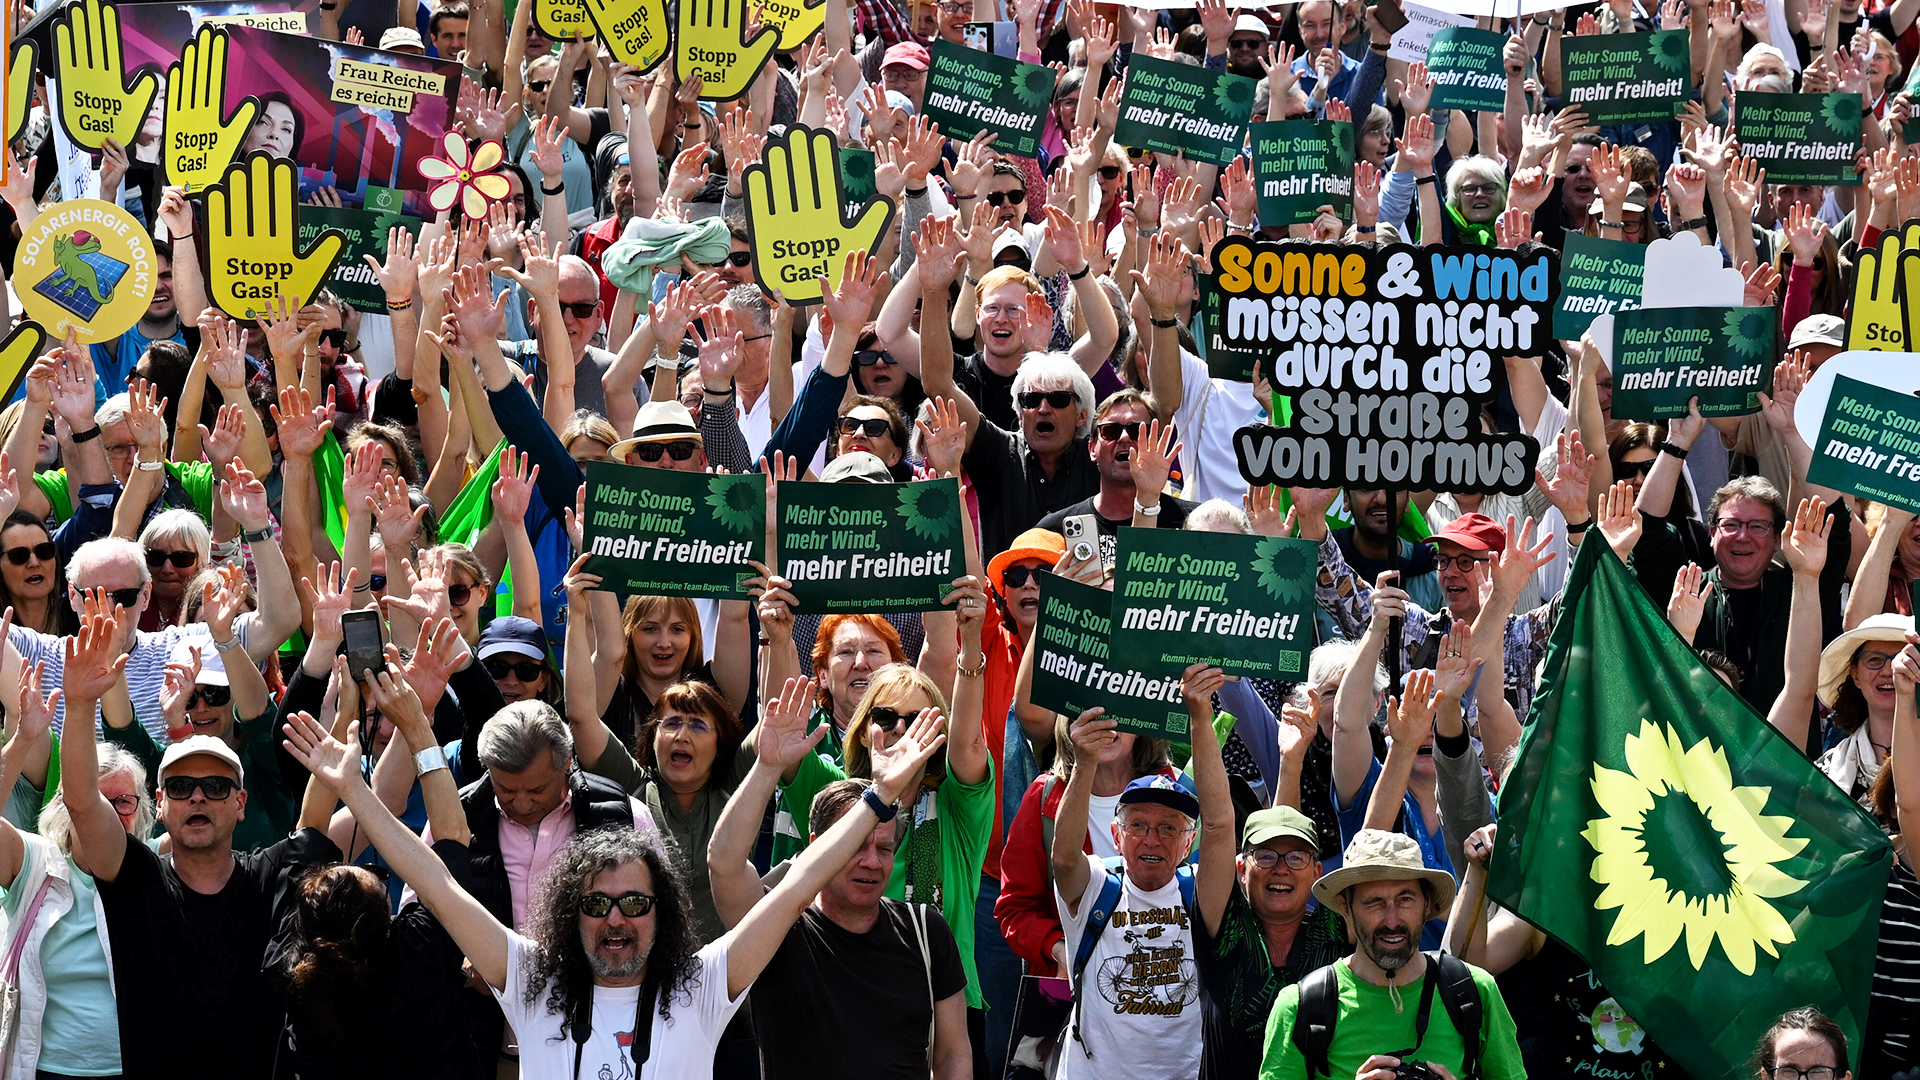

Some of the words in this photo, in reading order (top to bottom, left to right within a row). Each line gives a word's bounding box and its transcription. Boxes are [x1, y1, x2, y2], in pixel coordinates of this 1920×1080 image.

[551, 10, 586, 22] Gas!
[612, 5, 648, 40] Stopp
[625, 26, 652, 55] Gas!
[1432, 40, 1459, 53] Mehr
[1459, 41, 1496, 58] Sonne,
[688, 47, 736, 67] Stopp
[1428, 55, 1456, 67] mehr
[1457, 55, 1487, 72] Wind,
[1568, 51, 1600, 65] Mehr
[1601, 49, 1642, 63] Sonne,
[340, 63, 377, 81] Frau
[382, 70, 439, 94] Reiche,
[936, 56, 965, 75] Mehr
[965, 64, 1003, 88] Sonne,
[1426, 69, 1463, 86] mehr
[1569, 66, 1601, 81] mehr
[1604, 65, 1636, 79] Wind,
[932, 74, 962, 92] mehr
[962, 81, 993, 103] Wind,
[1133, 70, 1166, 87] Mehr
[1166, 77, 1206, 99] Sonne,
[1570, 83, 1613, 102] mehr
[1615, 78, 1683, 100] Freiheit!
[74, 91, 122, 115] Stopp
[336, 88, 352, 99] es
[356, 90, 408, 109] reicht!
[1129, 88, 1163, 104] mehr
[1163, 93, 1196, 114] Wind,
[928, 92, 968, 114] mehr
[967, 100, 1037, 132] Freiheit!
[1741, 106, 1772, 120] Mehr
[1773, 108, 1814, 124] Sonne,
[79, 115, 114, 133] Gas!
[1125, 106, 1170, 127] mehr
[1169, 112, 1239, 142] Freiheit!
[1741, 124, 1772, 138] mehr
[1774, 125, 1807, 140] Wind,
[175, 132, 218, 150] Stopp
[1259, 139, 1291, 155] Mehr
[1293, 137, 1329, 154] Sonne,
[1741, 141, 1783, 159] mehr
[1784, 142, 1854, 160] Freiheit!
[177, 153, 207, 172] Gas!
[1261, 157, 1294, 173] mehr
[1297, 156, 1327, 172] Wind,
[1264, 175, 1308, 197] mehr
[1311, 173, 1352, 197] Freiheit!
[299, 223, 320, 238] ehr
[22, 208, 130, 266] SOLARENERGIE
[126, 236, 149, 298] ROCKT!
[773, 238, 840, 259] Stopp
[227, 258, 293, 280] Stopp
[781, 260, 829, 283] Gas!
[1218, 243, 1366, 297] Sonne
[1377, 252, 1423, 299] &
[1431, 253, 1549, 302] Wind
[1569, 253, 1610, 273] Mehr
[231, 282, 279, 299] Gas!
[1567, 274, 1607, 291] mehr
[1562, 295, 1617, 315] mehr
[1227, 296, 1400, 346] müssen
[1415, 301, 1539, 350] nicht
[1623, 328, 1661, 345] Mehr
[1663, 327, 1714, 344] Sonne,
[1622, 348, 1662, 365] mehr
[1664, 346, 1705, 364] Wind,
[1275, 342, 1408, 391] durch
[1422, 347, 1492, 394] die
[1621, 368, 1674, 390] mehr
[1676, 364, 1762, 387] Freiheit!
[1299, 388, 1469, 440] Straße
[1837, 395, 1883, 422] Mehr
[1831, 418, 1879, 443] mehr
[1242, 435, 1330, 481] von
[1345, 437, 1526, 487] Hormus
[1824, 438, 1888, 470] mehr
[594, 484, 638, 507] Mehr
[638, 489, 695, 515] Sonne,
[1854, 483, 1876, 496] Komm
[1876, 488, 1888, 499] ins
[1888, 493, 1909, 506] grüne
[593, 510, 637, 526] mehr
[640, 513, 686, 537] Wind,
[785, 505, 826, 525] Mehr
[828, 506, 888, 528] Sonne,
[591, 535, 652, 560] mehr
[652, 537, 753, 565] Freiheit!
[785, 531, 828, 549] mehr
[832, 530, 881, 552] Wind,
[785, 555, 846, 581] mehr
[850, 549, 951, 579] Freiheit!
[1126, 552, 1176, 573] Mehr
[1177, 554, 1240, 581] Sonne,
[627, 579, 649, 588] Komm
[662, 581, 682, 591] grüne
[683, 583, 702, 591] Team
[702, 583, 730, 592] Bayern:
[1124, 578, 1175, 599] mehr
[1177, 580, 1228, 606] Wind,
[850, 599, 861, 607] ins
[863, 599, 884, 608] grüne
[905, 598, 934, 607] Bayern:
[1045, 596, 1080, 624] Mehr
[1121, 604, 1190, 631] mehr
[1191, 606, 1299, 641] Freiheit!
[1043, 624, 1078, 649] mehr
[1079, 633, 1109, 660] Win
[1161, 653, 1185, 663] Komm
[1186, 655, 1198, 663] ins
[1222, 658, 1242, 667] Team
[1243, 660, 1272, 671] Bayern:
[1040, 650, 1087, 683] mehr
[1085, 662, 1184, 704] Freiheit!
[1131, 718, 1159, 730] Bayern:
[1126, 952, 1150, 963] EINEN
[1132, 960, 1178, 977] HERRN
[1131, 977, 1145, 986] MIT
[1148, 974, 1180, 986] SEINEM
[1114, 990, 1184, 1015] Fahrrad
[1566, 998, 1581, 1010] is
[1574, 1059, 1635, 1079] plan
[1642, 1060, 1653, 1080] B
